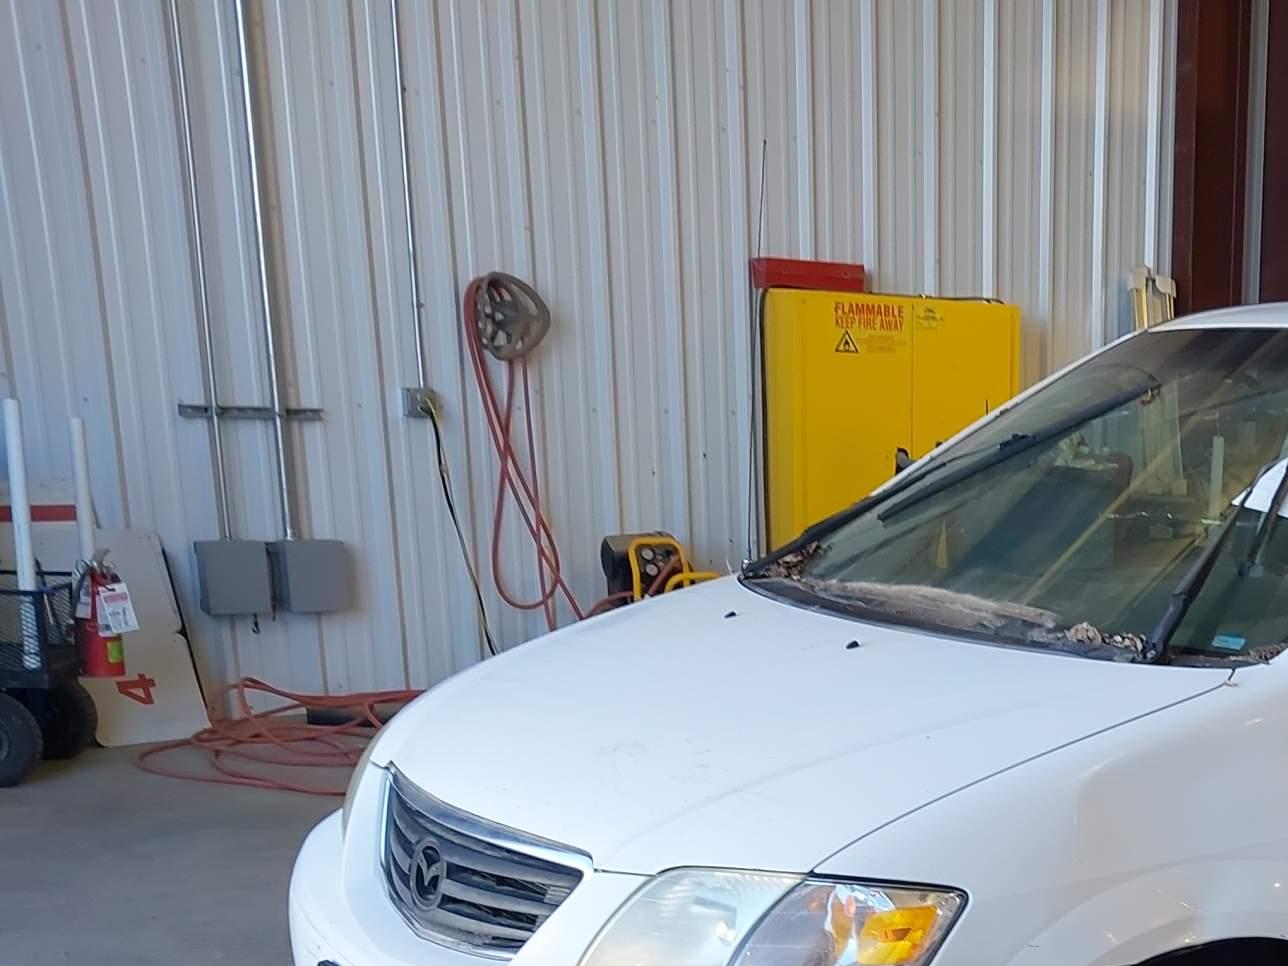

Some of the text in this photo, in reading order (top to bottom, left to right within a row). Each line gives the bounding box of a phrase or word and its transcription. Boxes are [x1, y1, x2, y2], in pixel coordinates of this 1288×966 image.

[834, 301, 904, 319] FLAMMABLE
[835, 316, 904, 332] KEEP FIRE AWAY
[116, 672, 157, 705] 4
